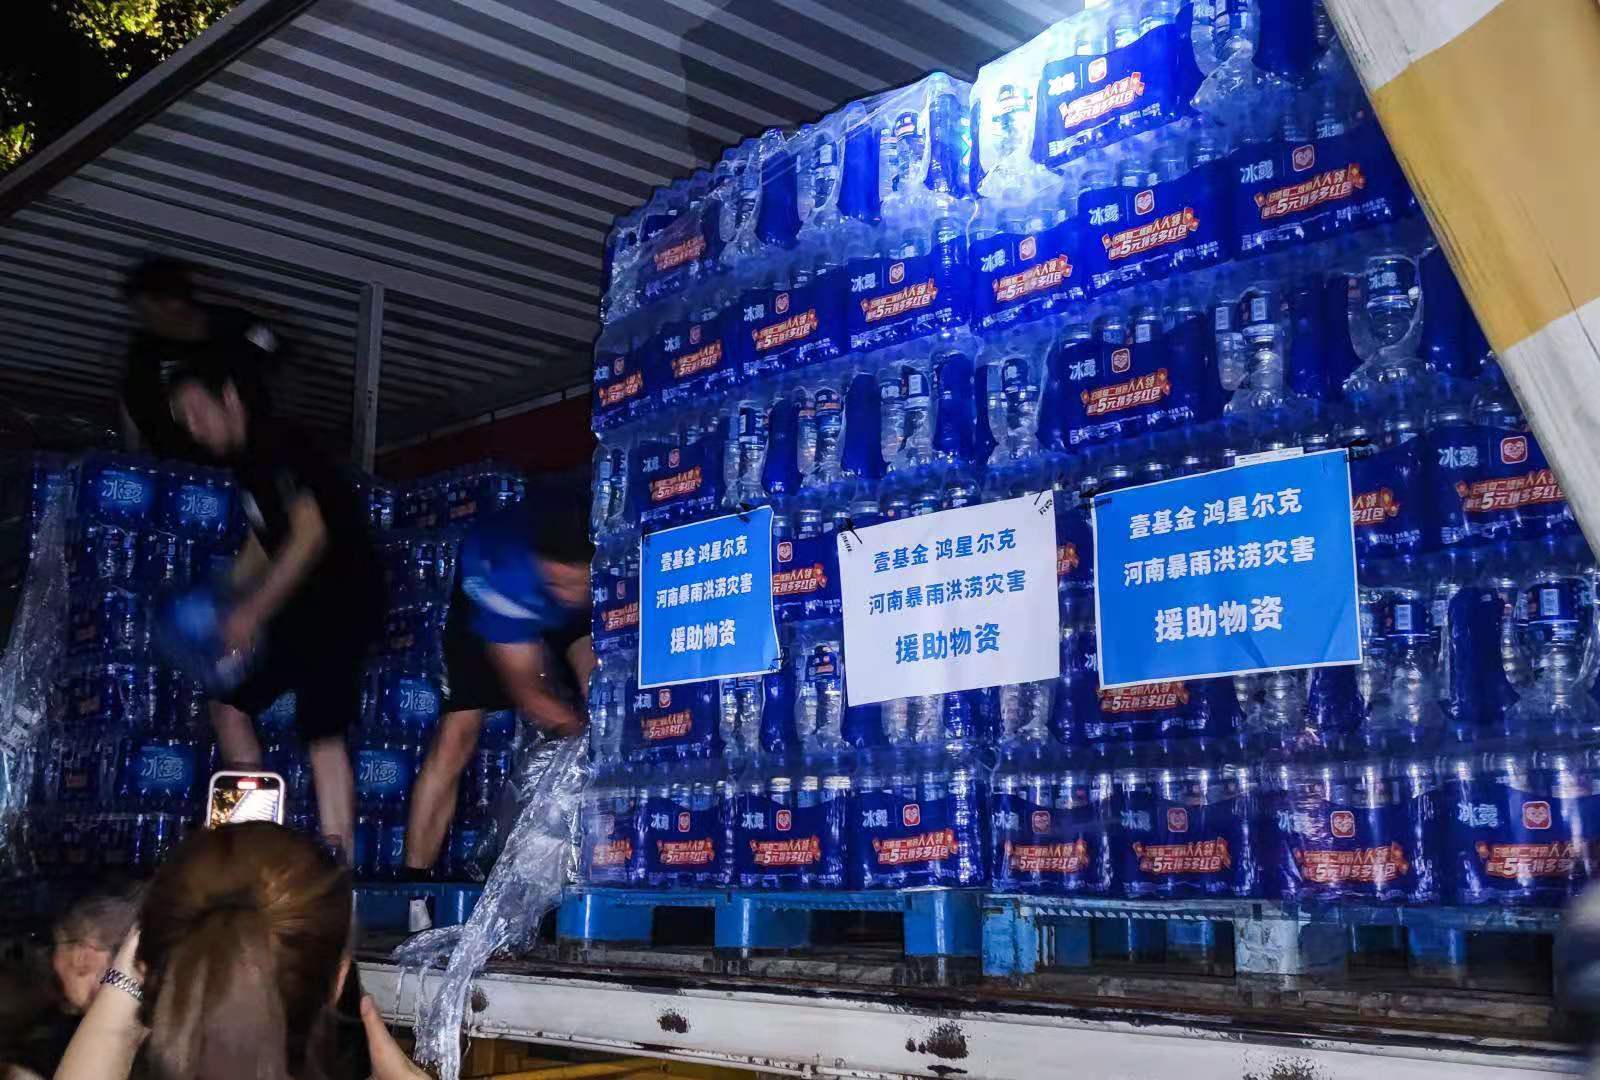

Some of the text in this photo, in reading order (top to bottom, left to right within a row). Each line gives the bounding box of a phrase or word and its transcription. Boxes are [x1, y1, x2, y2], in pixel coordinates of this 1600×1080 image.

[1239, 160, 1274, 184] 冰露
[1089, 203, 1120, 226] 冰露
[1069, 359, 1096, 380] 冰露
[1438, 446, 1479, 468] 冰露
[103, 479, 143, 503] 冰露
[181, 495, 217, 518] 冰露
[1129, 487, 1303, 540] 壹基金 鸿星尔克
[660, 534, 748, 573] 壹基金 鸿星尔克
[874, 528, 1017, 573] 壹基金 鸿星尔克
[1124, 535, 1315, 587] 河南暴雨洪涝灾害
[656, 572, 753, 609] 河南暴雨洪涝灾害
[869, 569, 1026, 615] 河南暴雨洪涝灾害
[1155, 595, 1284, 643] 援助物资
[670, 618, 736, 655] 援助物资
[896, 623, 1001, 664] 援助物资
[400, 690, 435, 713] 冰露
[1102, 694, 1177, 711] 5元拼多多红包
[141, 754, 184, 781] 冰露
[360, 759, 400, 785] 冰露
[1458, 803, 1498, 827] 冰露
